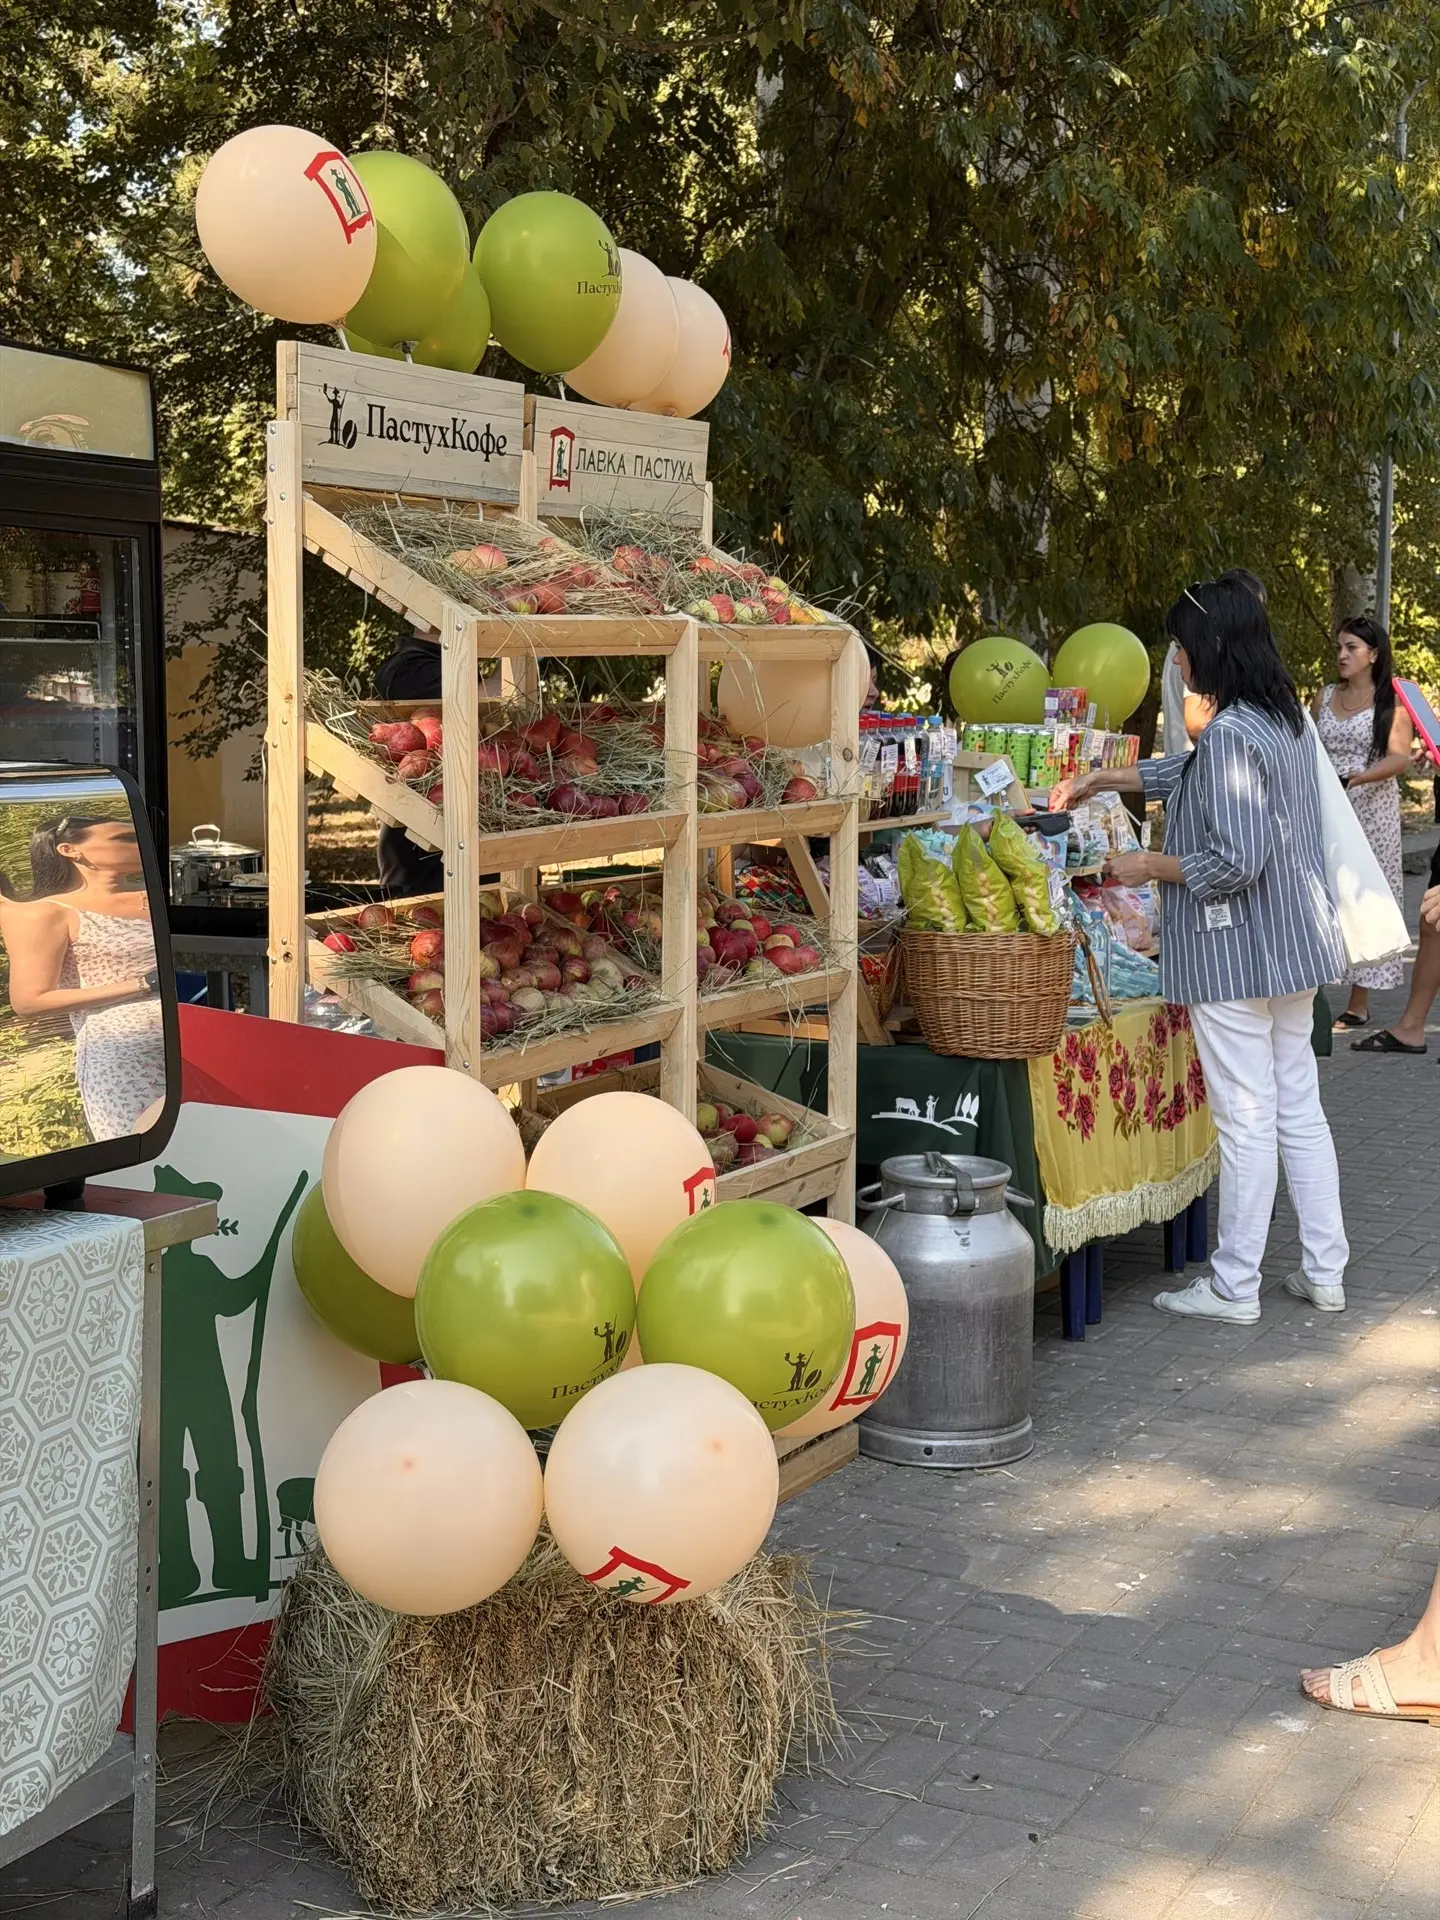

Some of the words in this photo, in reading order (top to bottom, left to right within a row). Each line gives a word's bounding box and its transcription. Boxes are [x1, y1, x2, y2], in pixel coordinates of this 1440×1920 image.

[366, 403, 507, 463] ПастухКофе
[575, 447, 626, 476] ЛАВКА
[633, 454, 695, 482] ПАСТУХА
